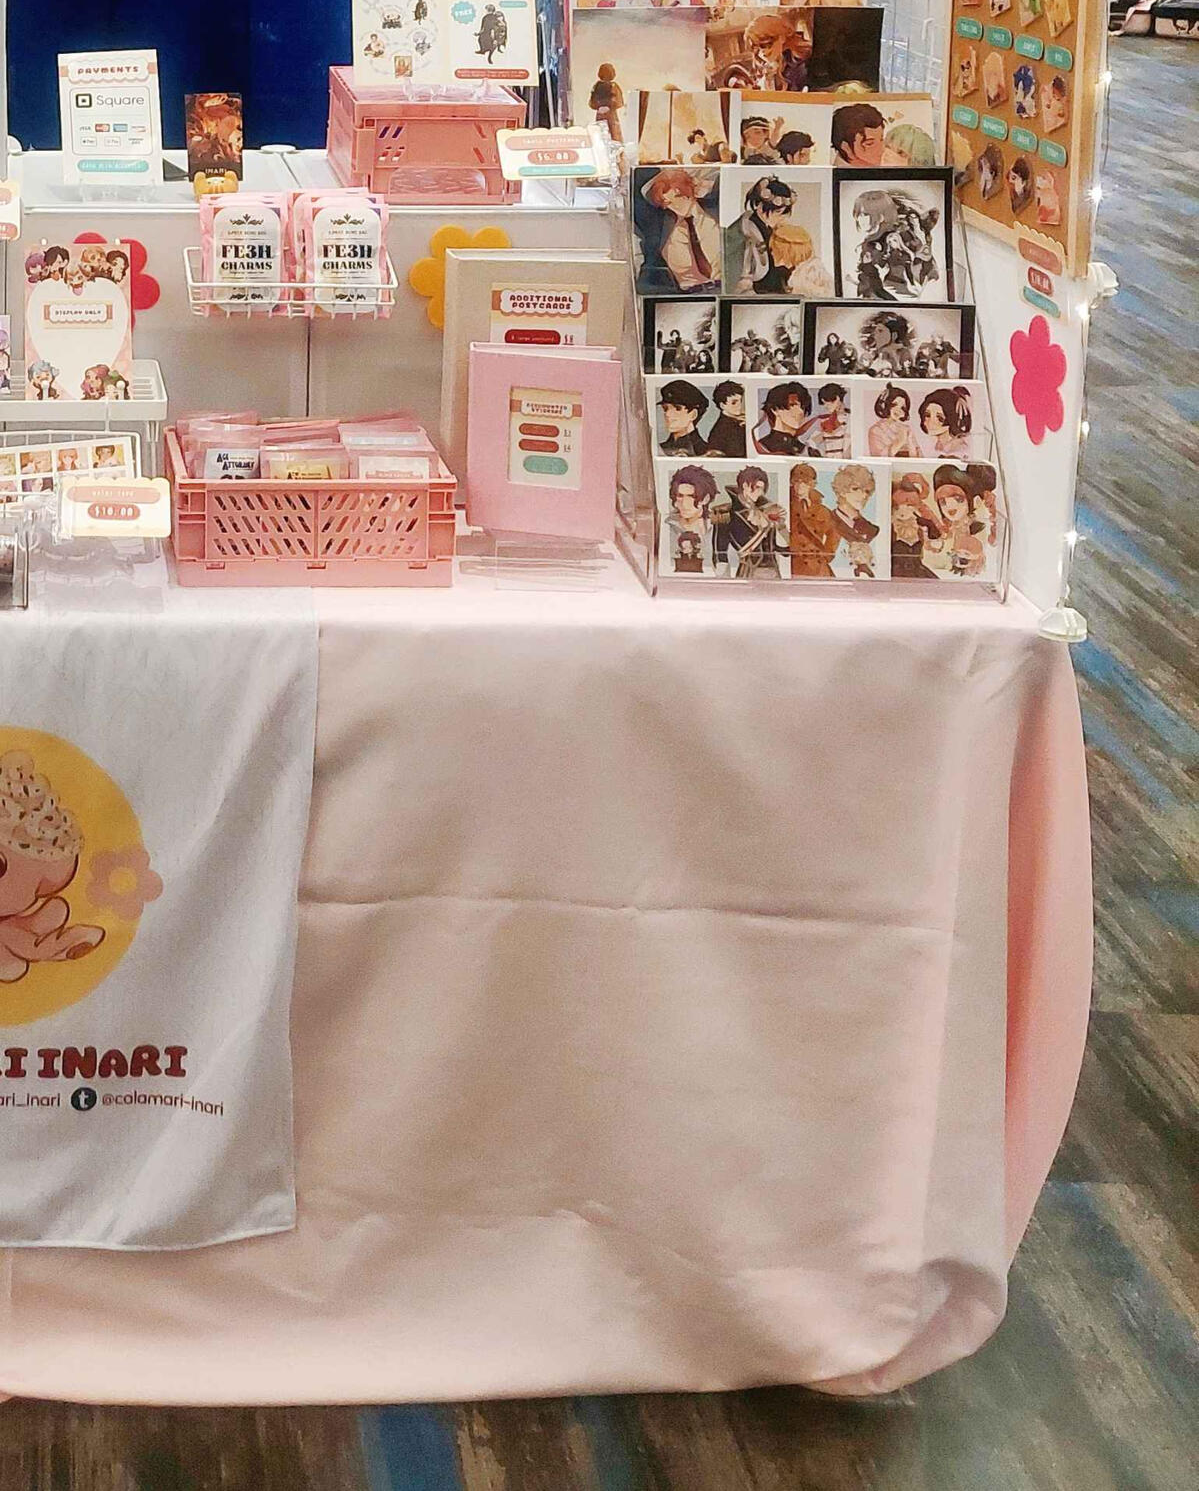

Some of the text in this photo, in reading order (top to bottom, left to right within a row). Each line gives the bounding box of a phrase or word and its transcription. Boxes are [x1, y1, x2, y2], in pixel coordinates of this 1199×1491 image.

[77, 65, 139, 76] PAYMENTS
[96, 95, 145, 108] Square
[221, 245, 274, 260] FE3H
[323, 244, 373, 259] FE3H
[221, 261, 273, 271] CHARMS
[322, 261, 373, 270] CHARMS
[509, 294, 575, 304] ADDITIONAL
[511, 302, 572, 311] POSTCARDS
[95, 506, 135, 517] $10.00
[37, 1044, 188, 1079] INARI
[101, 1092, 224, 1116] @calamari-inari
